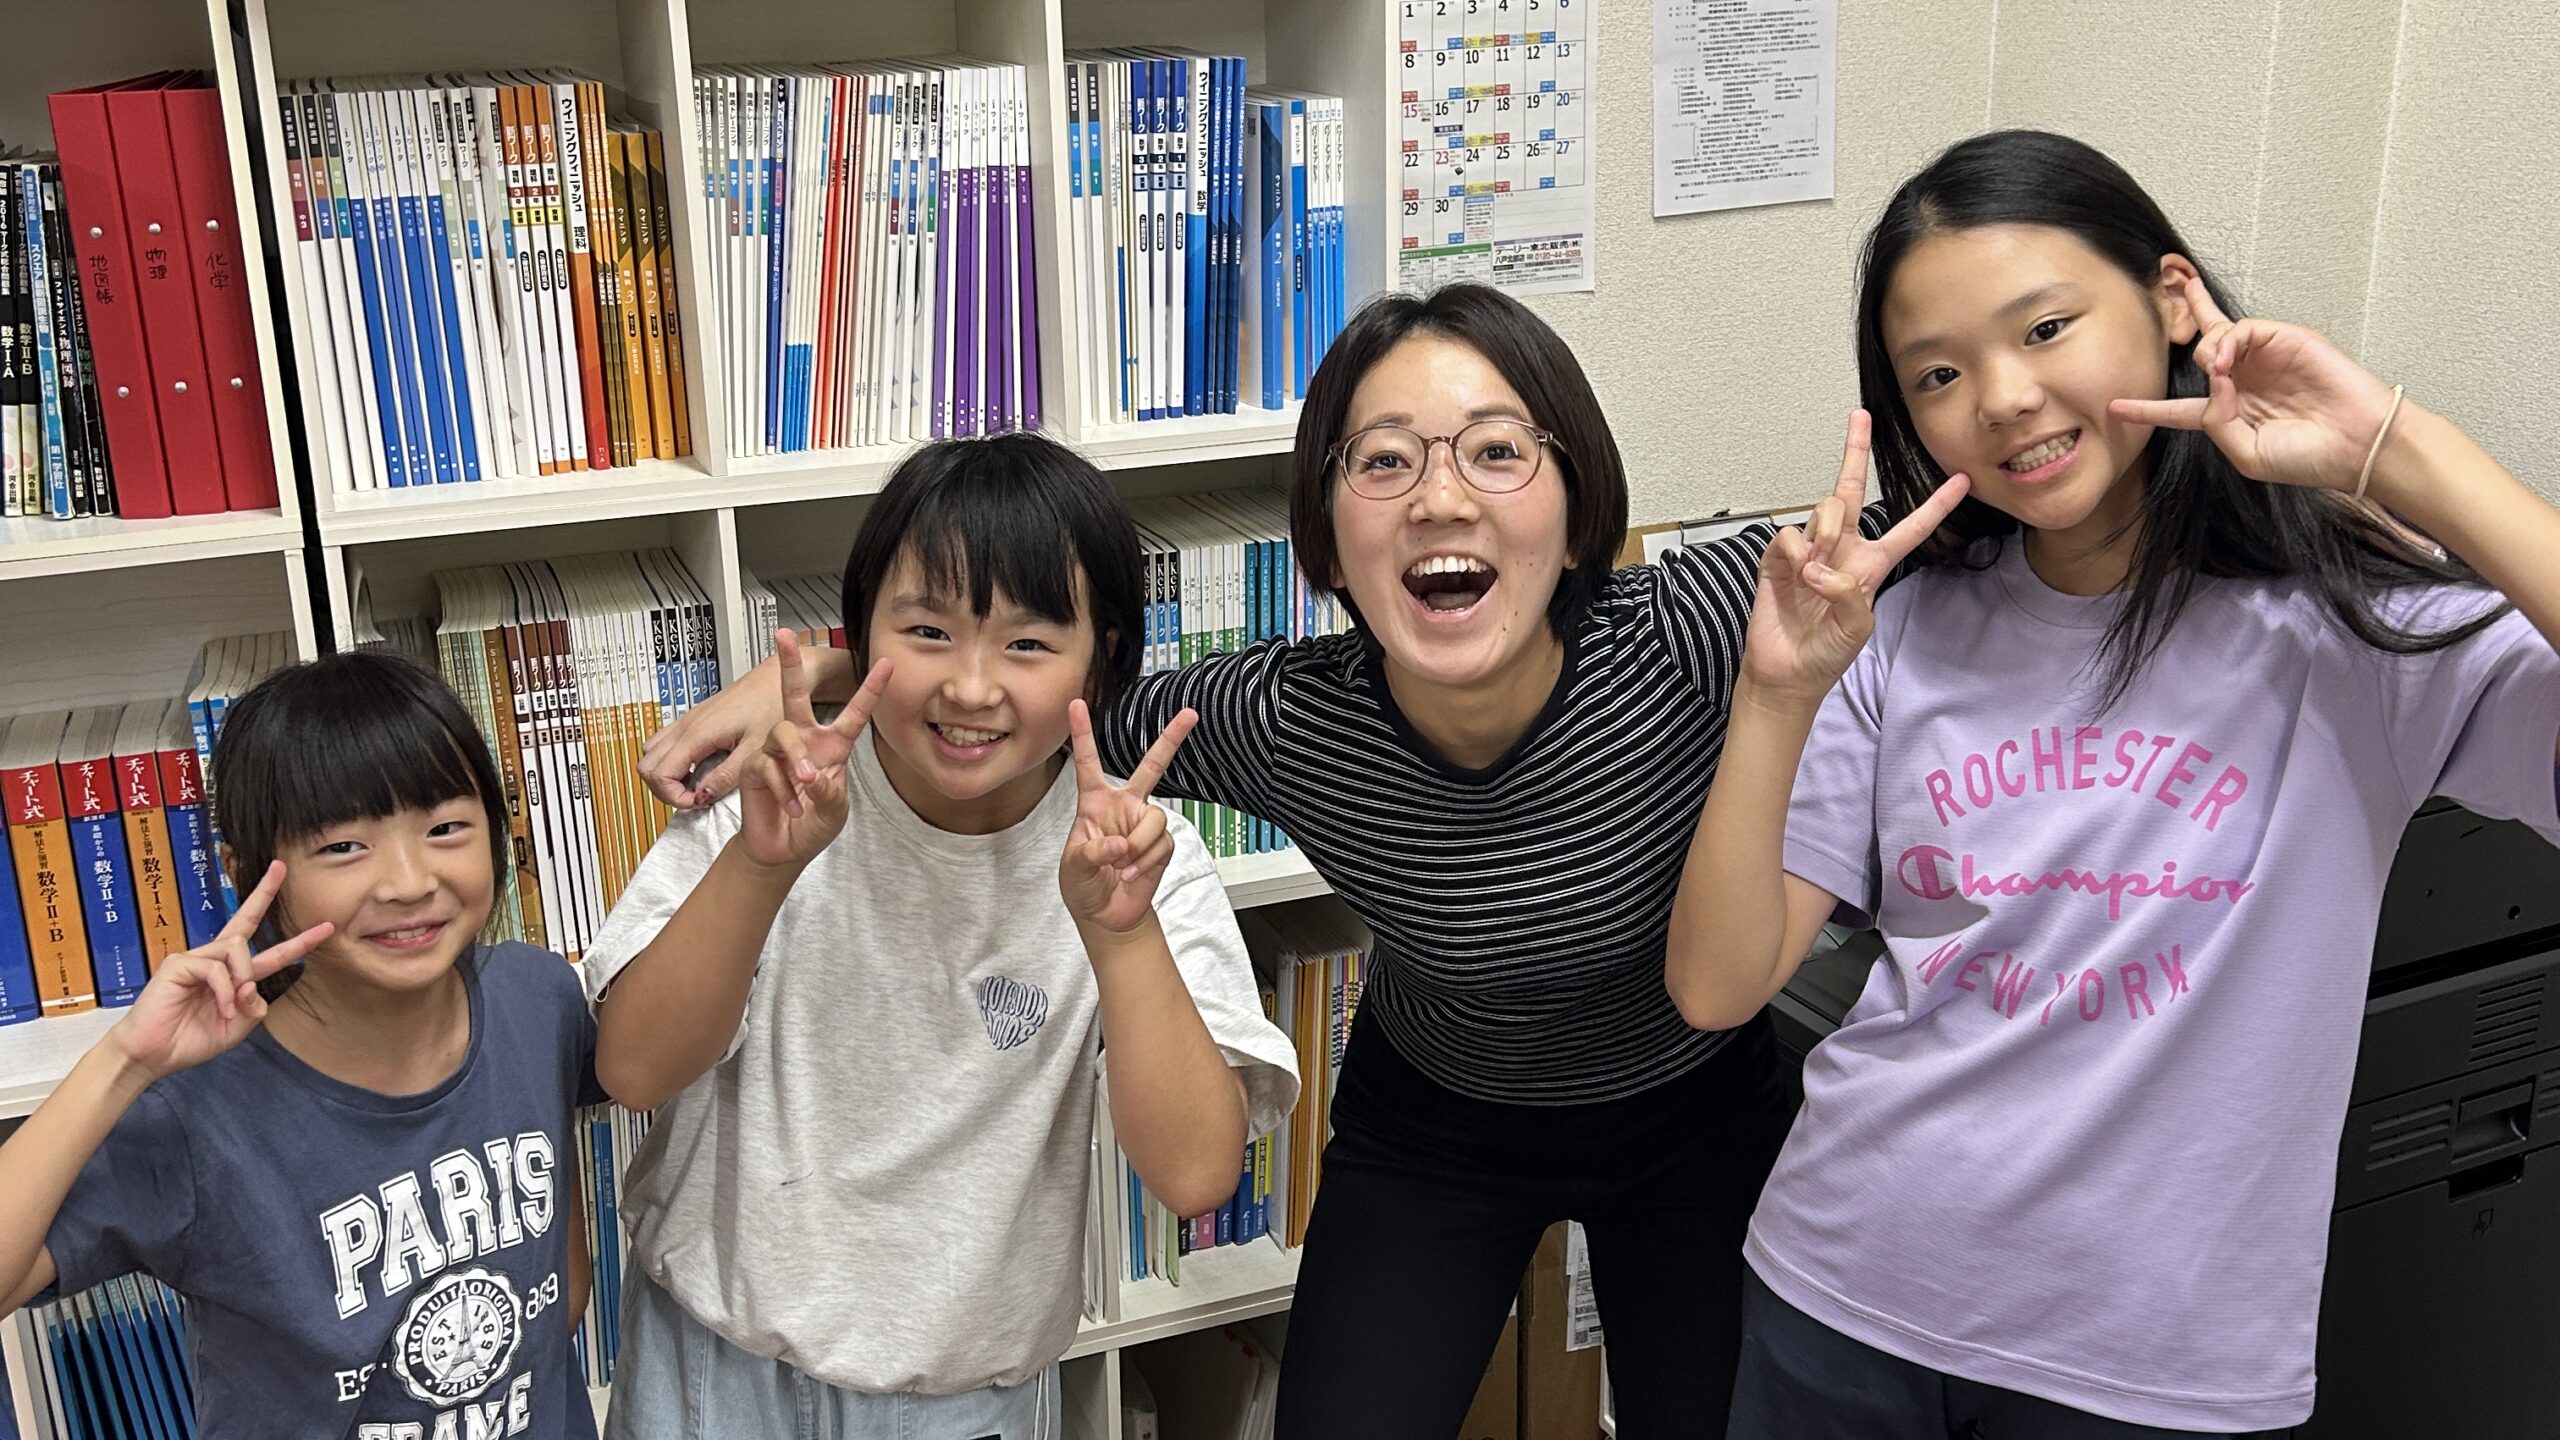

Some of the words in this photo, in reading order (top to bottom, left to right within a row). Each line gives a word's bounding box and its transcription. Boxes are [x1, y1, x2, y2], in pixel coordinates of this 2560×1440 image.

[1406, 5, 1414, 17] 1
[1437, 2, 1446, 16] 2
[1468, 0, 1477, 14] 3
[1499, 0, 1508, 12] 4
[1530, 0, 1539, 10] 5
[1405, 54, 1414, 68] 8
[1437, 52, 1445, 66] 9
[1466, 51, 1479, 64] 10
[1497, 48, 1509, 62] 11
[1527, 46, 1540, 59] 12
[1557, 44, 1570, 57] 13
[1405, 104, 1417, 118] 15
[1435, 102, 1449, 116] 16
[1466, 100, 1479, 113] 17
[1497, 98, 1510, 111] 18
[1527, 95, 1540, 108] 19
[1557, 93, 1569, 106] 20
[1405, 154, 1418, 167] 22
[1436, 151, 1449, 164] 23
[1466, 148, 1479, 162] 24
[1496, 146, 1510, 159] 25
[1527, 143, 1540, 157] 26
[1557, 141, 1569, 154] 27
[1197, 190, 1207, 212] 数学
[1405, 202, 1418, 215] 29
[1435, 199, 1449, 213] 30
[573, 226, 588, 250] 理科
[89, 255, 116, 304] 地図帳
[145, 250, 168, 282] 物理
[205, 252, 229, 291] 化学
[625, 291, 635, 305] 3
[647, 291, 657, 304] 2
[667, 288, 673, 301] 1
[668, 619, 679, 658] Key
[685, 619, 696, 657] Key
[704, 616, 714, 655] Key
[652, 620, 664, 659] Key
[658, 665, 669, 699] ワーク
[708, 661, 719, 694] ワーク
[673, 664, 684, 698] ワーク
[690, 662, 700, 696] ワーク
[79, 762, 101, 812] チャート式
[125, 758, 150, 807] チャート式
[175, 752, 196, 800] チャート式
[1925, 726, 2249, 832] ROCHESTER
[19, 770, 45, 820] チャート式
[1917, 935, 2035, 1020] NEW
[2040, 943, 2190, 1027] YORK
[319, 1130, 555, 1321] PARIS
[408, 1285, 458, 1366] PRODUIT
[470, 1282, 513, 1346] ORIGINAL
[432, 1319, 451, 1361] EST
[436, 1372, 487, 1395] PARIS
